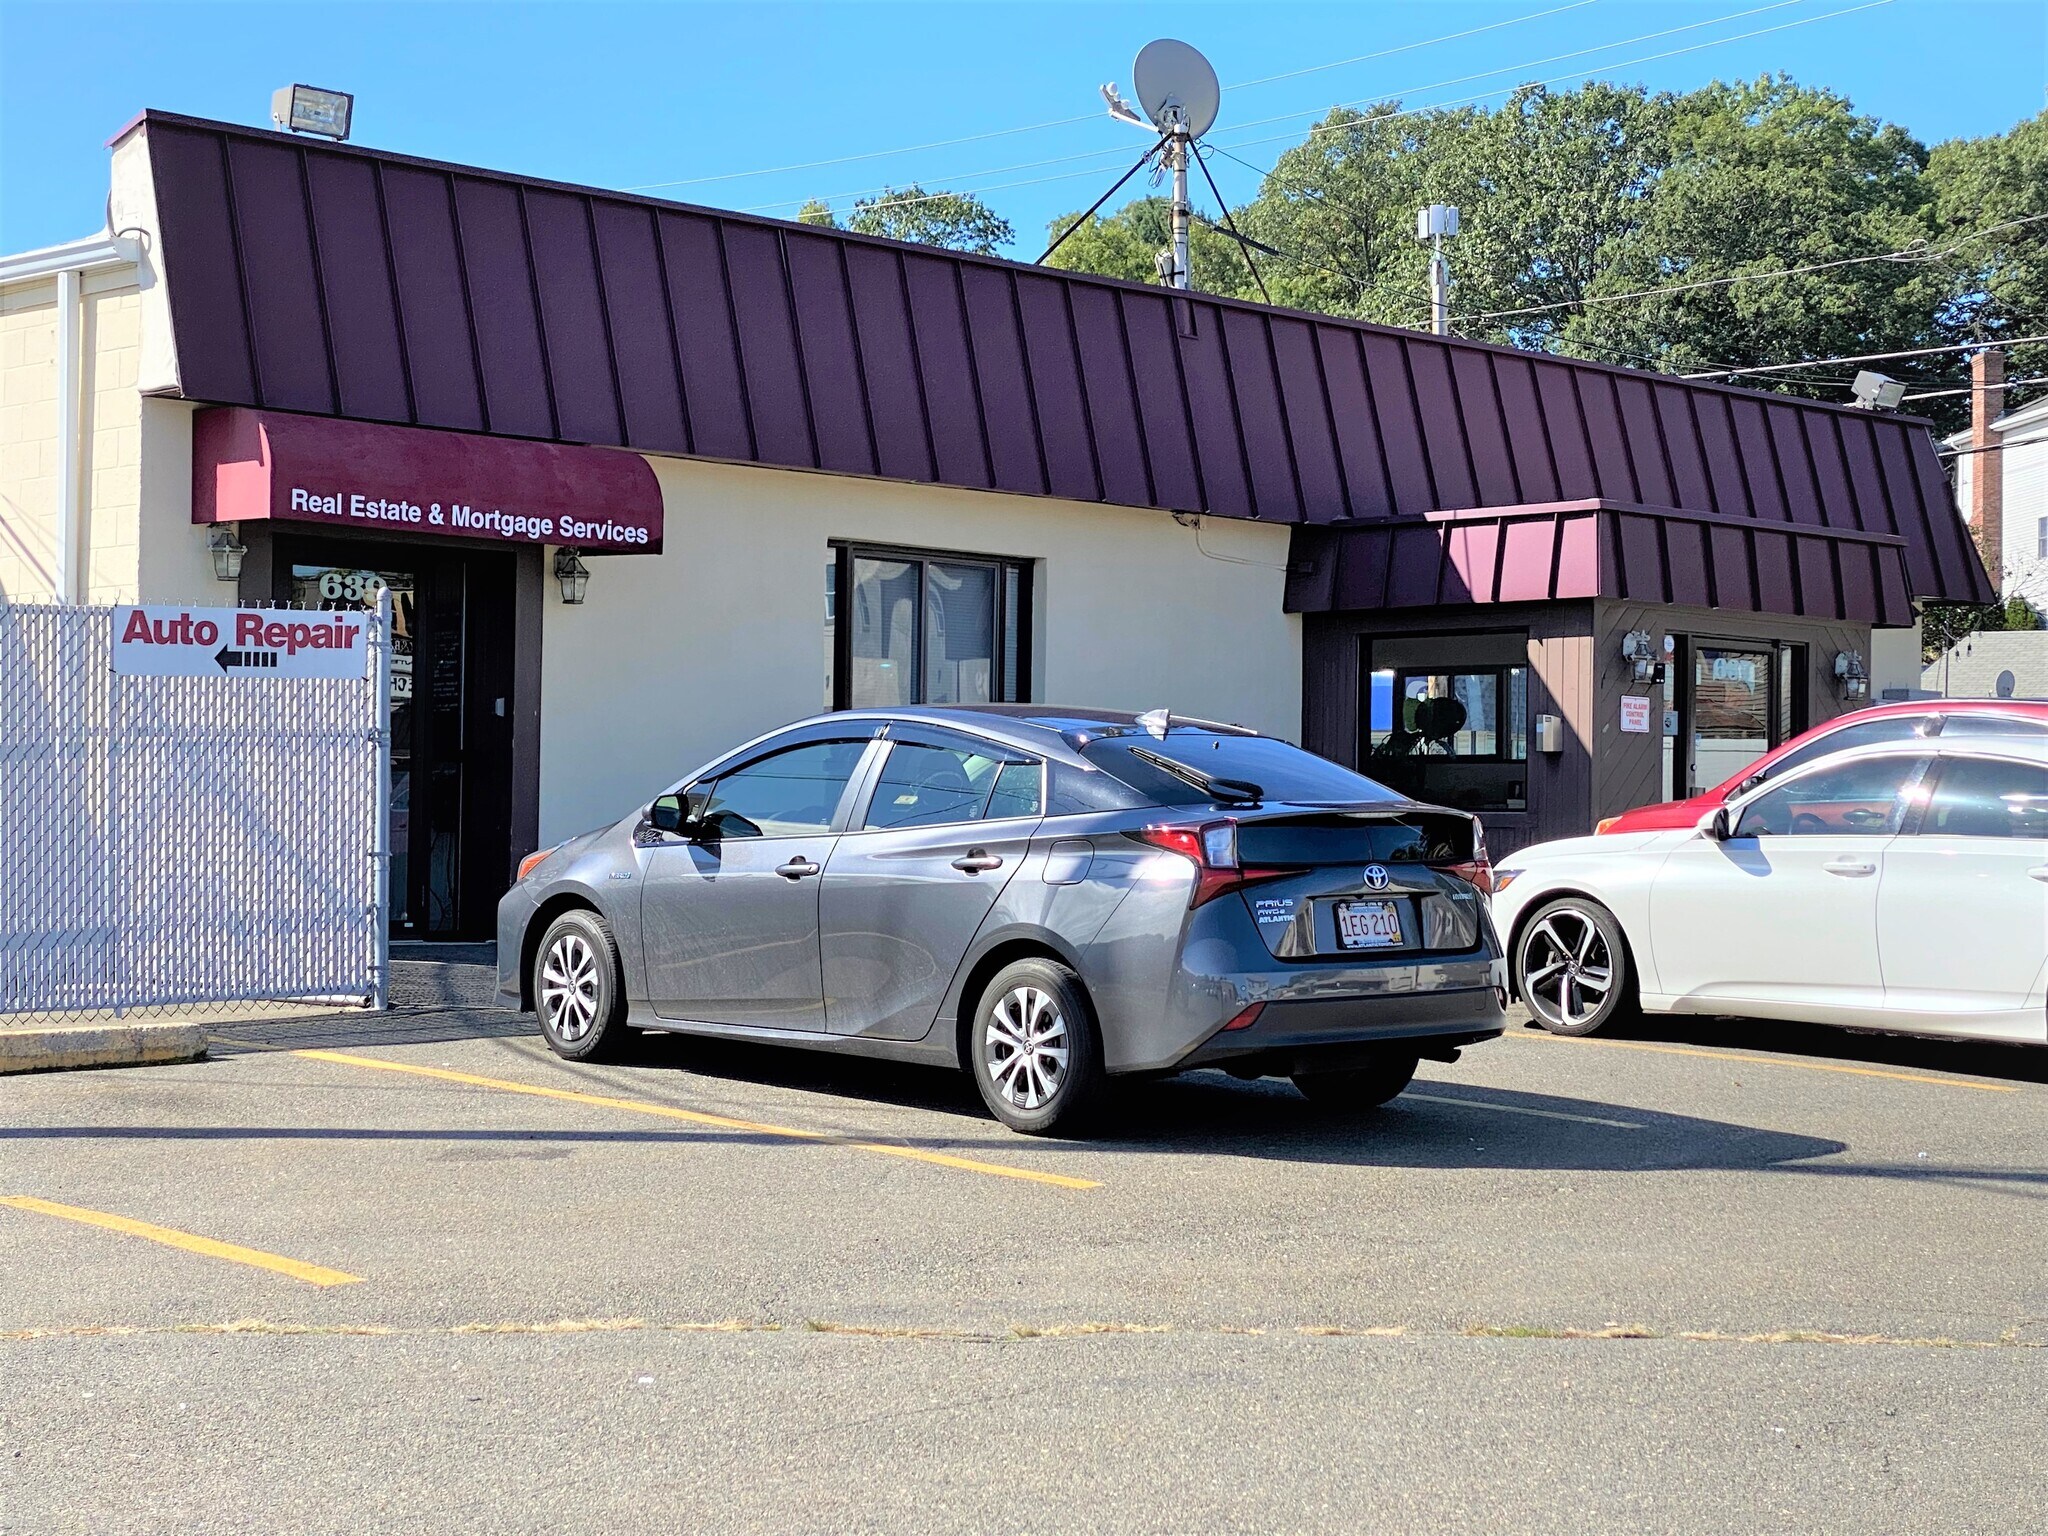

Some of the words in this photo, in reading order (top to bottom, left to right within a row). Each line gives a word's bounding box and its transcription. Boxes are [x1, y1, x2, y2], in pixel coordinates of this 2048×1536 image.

[291, 488, 342, 515] Real
[350, 495, 421, 523] Estate
[428, 503, 444, 526] &
[452, 504, 553, 540] Mortgage
[559, 516, 649, 544] Services
[319, 573, 387, 605] 639
[121, 610, 219, 646] Auto
[236, 613, 359, 655] Repair
[1255, 899, 1294, 908] PRIUS
[1258, 914, 1296, 923] ATLANTIC
[1341, 914, 1369, 937] 1EG
[1371, 913, 1398, 935] 210
